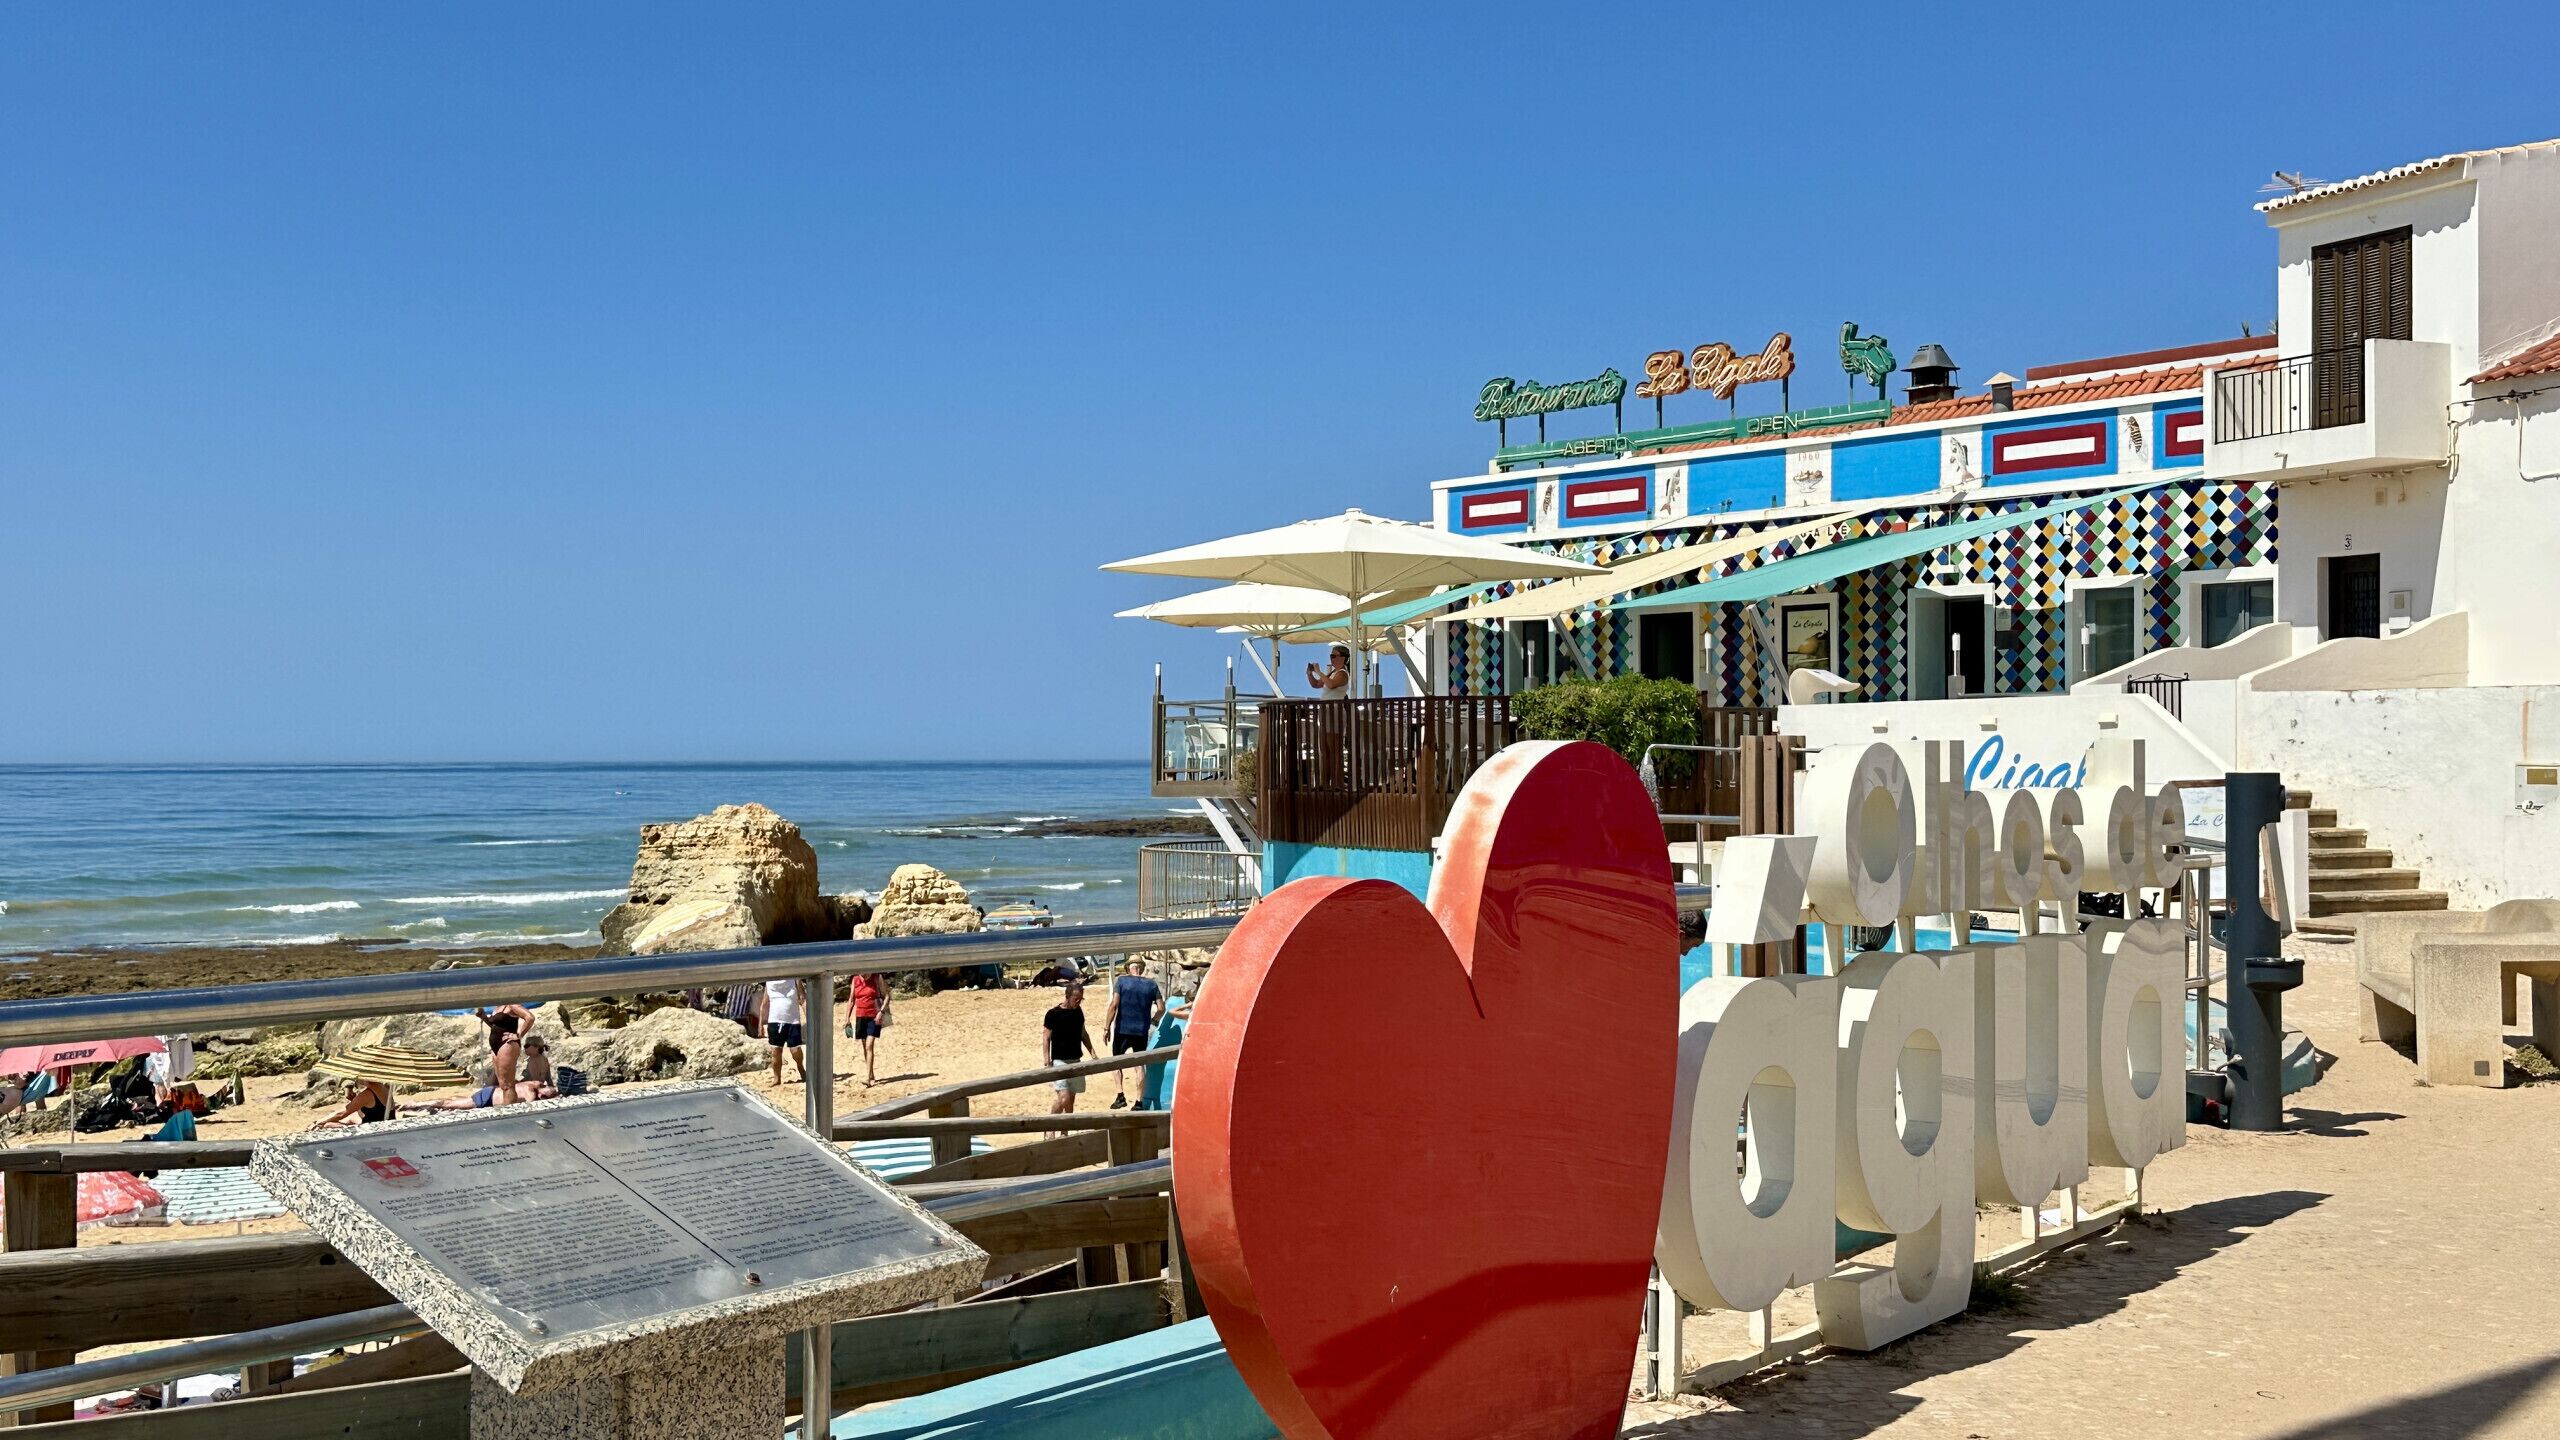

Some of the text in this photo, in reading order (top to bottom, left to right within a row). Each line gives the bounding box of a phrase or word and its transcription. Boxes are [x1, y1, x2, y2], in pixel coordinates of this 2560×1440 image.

[1635, 334, 1789, 398] La Cigale
[1474, 369, 1624, 420] Restaurante
[1563, 436, 1627, 456] ABERTO
[1746, 413, 1798, 433] OPEN
[1804, 739, 2186, 927] Olhos de
